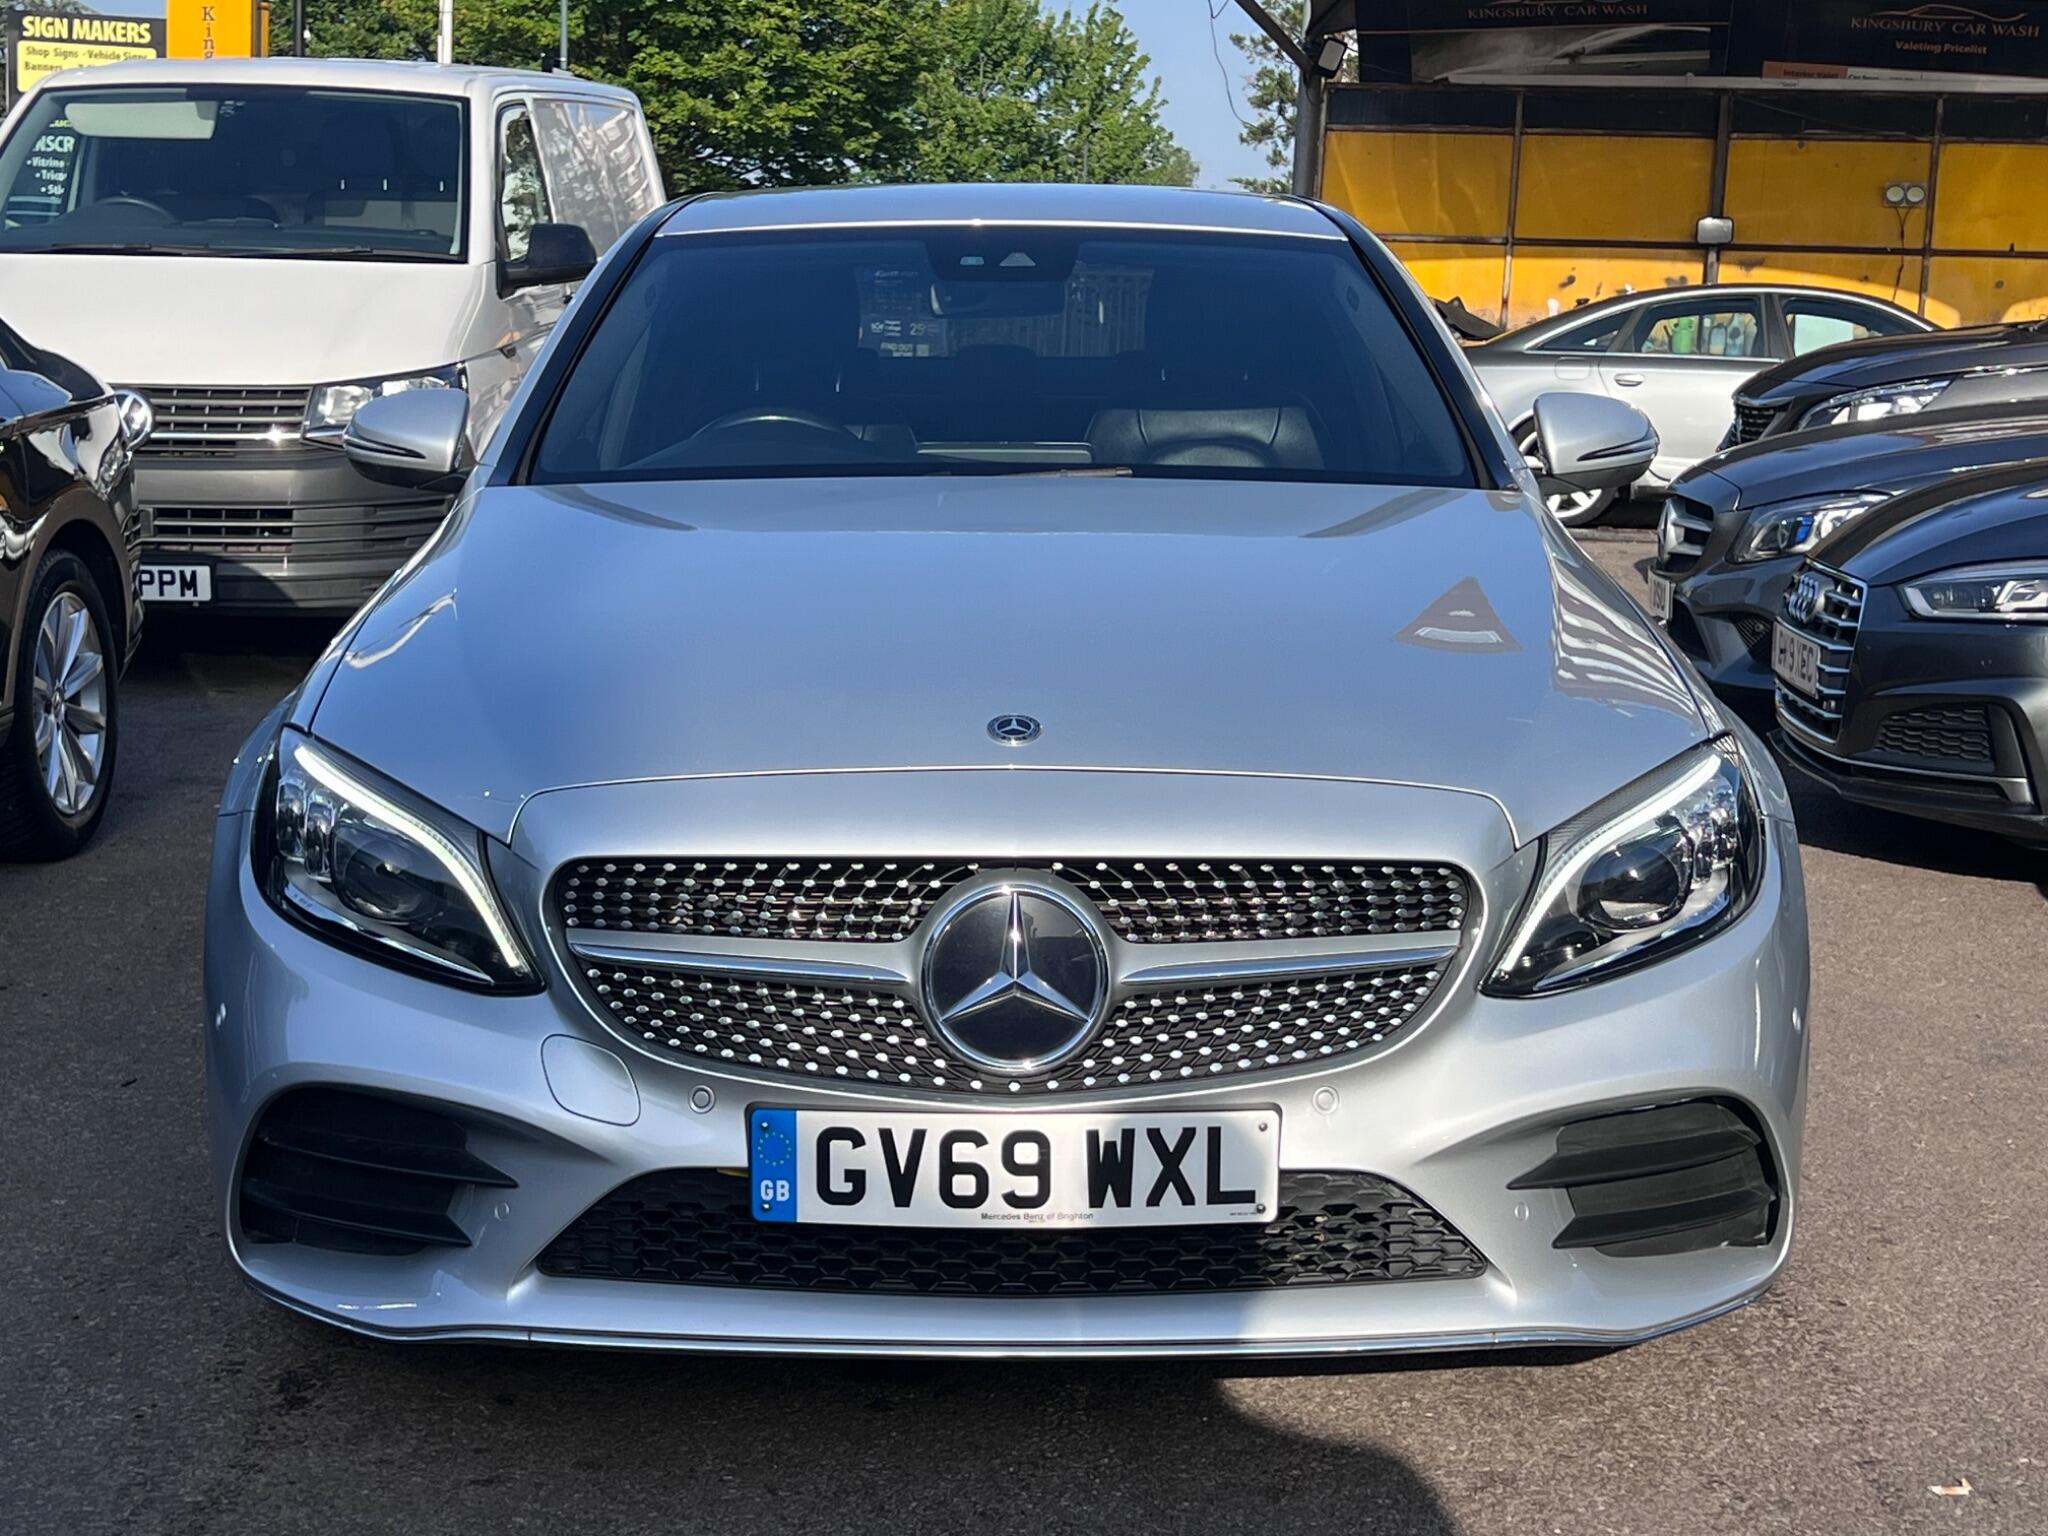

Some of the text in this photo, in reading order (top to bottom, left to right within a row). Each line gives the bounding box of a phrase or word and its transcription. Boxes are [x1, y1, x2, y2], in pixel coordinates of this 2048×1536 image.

[1467, 4, 1648, 19] KINGSBURY CAR WASH
[22, 15, 152, 44] SIGN MAKERS
[1850, 16, 2040, 38] KINGSBURY CAR WASH
[25, 46, 50, 58] Shop
[54, 47, 80, 60] Signs
[1895, 40, 1988, 55] Valeting Pricelist
[140, 570, 198, 597] PPM
[816, 1126, 1256, 1209] GV69 WXL
[760, 1180, 790, 1201] GB
[1057, 1213, 1094, 1222] Brighton
